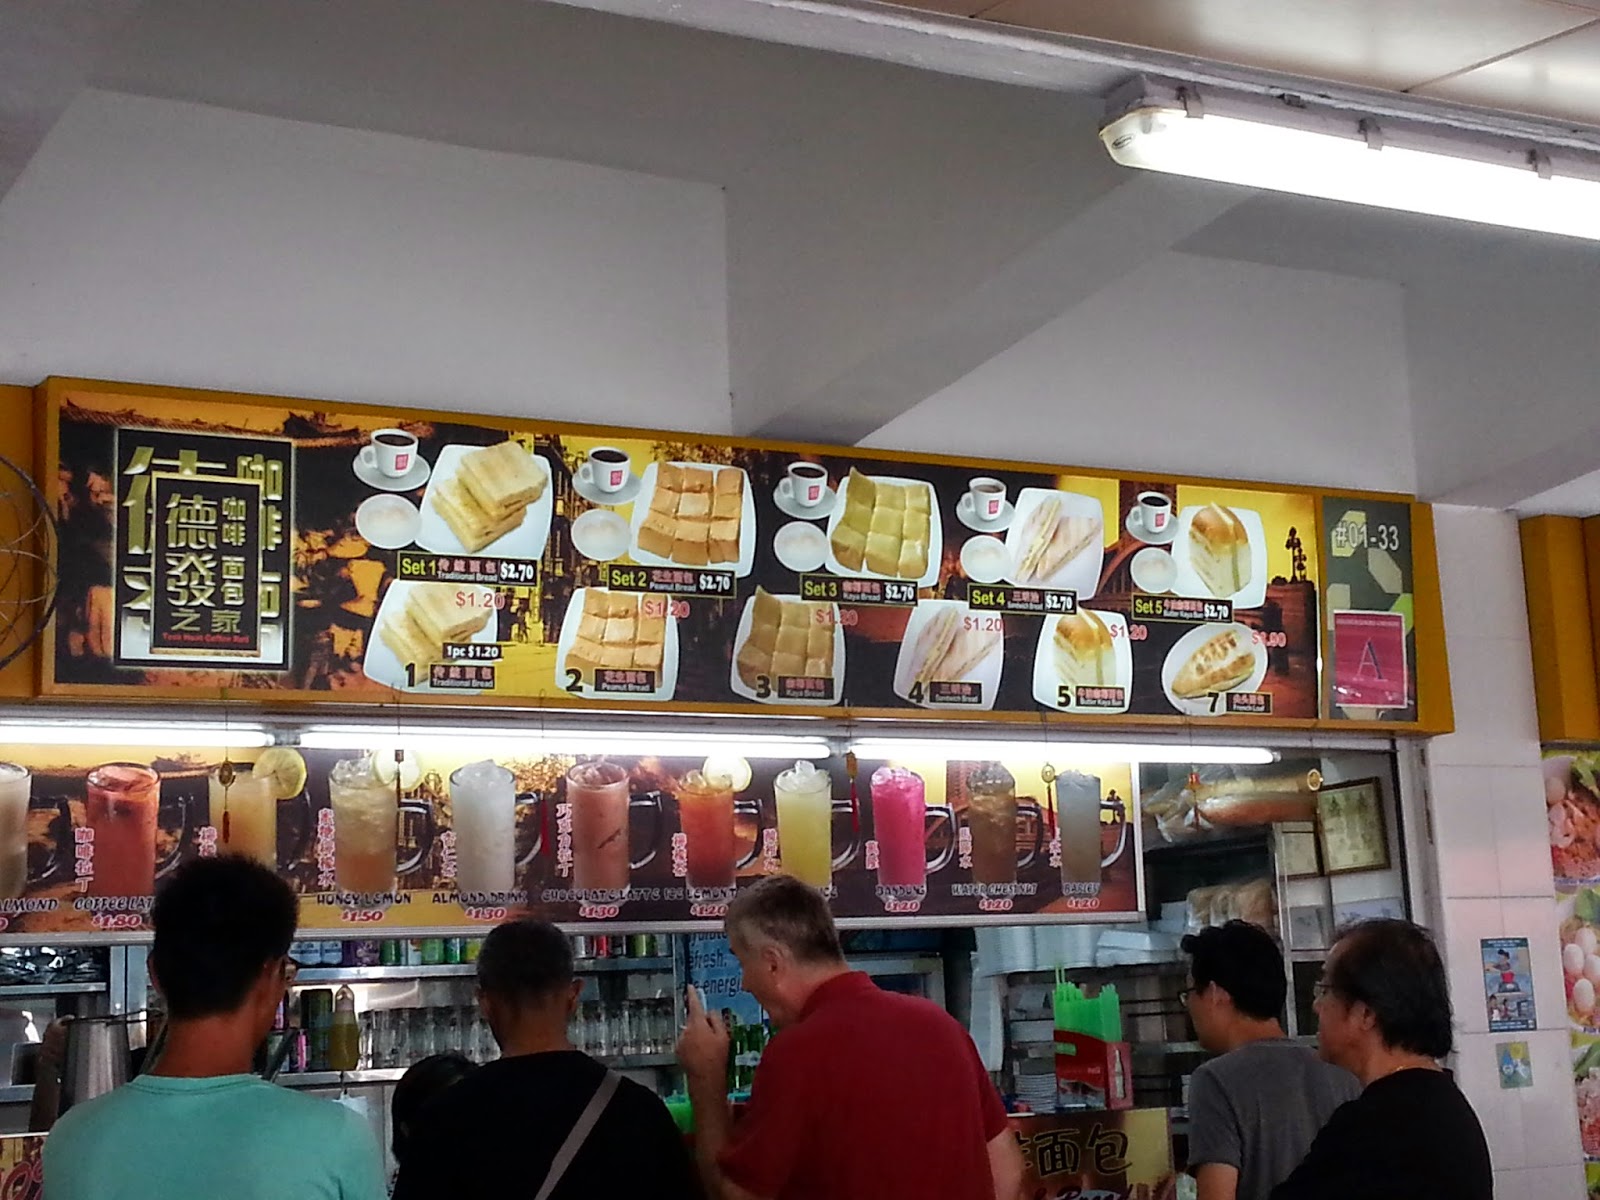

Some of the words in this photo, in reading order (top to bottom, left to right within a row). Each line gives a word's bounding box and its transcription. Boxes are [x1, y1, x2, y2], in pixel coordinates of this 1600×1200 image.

[1336, 521, 1399, 551] #01-33
[402, 558, 426, 576] Set
[429, 559, 436, 576] 1
[500, 561, 534, 582] $2.70
[437, 571, 475, 581] Traditional
[476, 573, 498, 582] Bread
[612, 570, 635, 586] Set
[638, 572, 647, 587] 2
[700, 574, 731, 592] $2.70
[650, 582, 674, 591] Peanut
[675, 584, 696, 592] Bread
[804, 580, 827, 596] Set
[829, 582, 837, 597] 3
[885, 584, 915, 601] $2.70
[456, 591, 505, 610] $1.20
[972, 590, 995, 606] Set
[996, 592, 1005, 606] 4
[1046, 595, 1073, 612] $2.70
[1135, 598, 1154, 614] Set
[1155, 600, 1162, 614] 5
[645, 600, 690, 618] $1.20
[1204, 602, 1229, 620] $2.70
[171, 608, 241, 634] 之家
[964, 616, 1002, 632] $1.20
[1110, 624, 1148, 641] $1.20
[447, 646, 466, 659] 1pc
[468, 646, 499, 658] $1.20
[1352, 637, 1388, 682] A
[406, 663, 416, 688] 1
[433, 678, 470, 687] Traditional
[472, 680, 494, 688] Bread
[566, 668, 583, 692] 2
[602, 683, 627, 691] Peanut
[628, 684, 650, 692] Bread
[756, 675, 771, 698] 3
[908, 681, 924, 703] 4
[1058, 686, 1070, 707] 5
[1208, 692, 1219, 713] 7
[432, 892, 486, 904] ALMOND
[490, 891, 529, 904] DRINK
[541, 888, 616, 902] CHOCOLATE
[620, 888, 661, 901] LATTE
[664, 887, 684, 900] ICE
[686, 886, 728, 900] LEMON
[876, 884, 927, 898] BANDUNG
[952, 884, 987, 896] WATER
[988, 882, 1038, 896] CHESTNUT
[1063, 882, 1100, 896] BARLEY
[74, 897, 128, 911] COFFEE
[317, 893, 359, 906] HONEY
[365, 892, 412, 905] LEMON
[885, 900, 921, 913] $1.20
[979, 898, 1013, 911] $1.20
[1067, 896, 1100, 909] $1.20
[92, 914, 142, 928] $1.80
[1016, 1123, 1133, 1178] 面包
